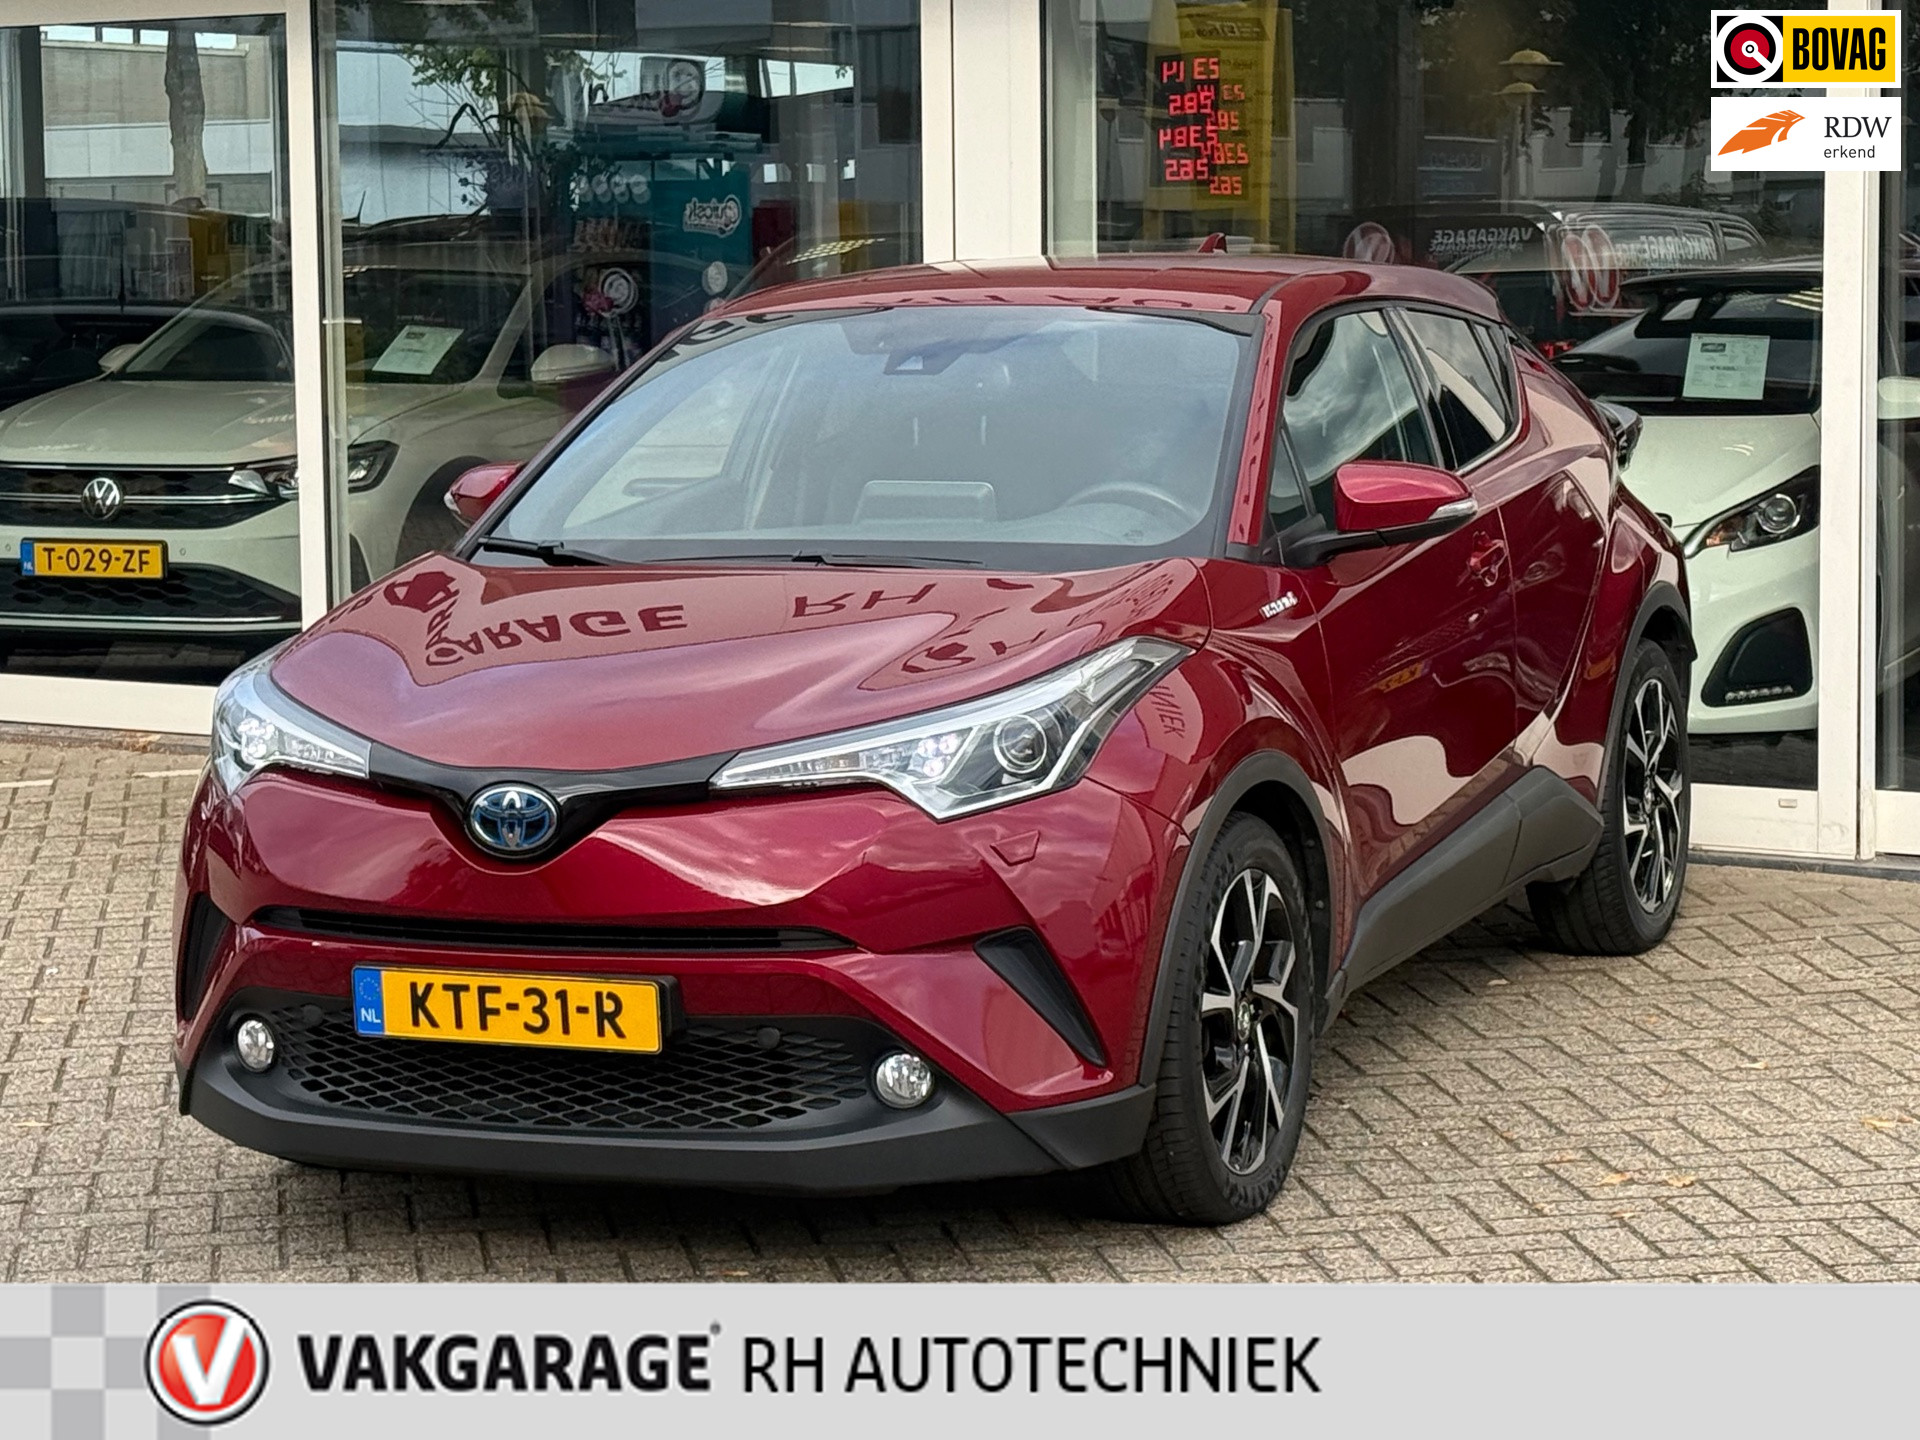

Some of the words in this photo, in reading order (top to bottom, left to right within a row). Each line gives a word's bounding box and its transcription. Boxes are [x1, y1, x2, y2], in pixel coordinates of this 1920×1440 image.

[42, 547, 150, 574] T-029-ZF
[360, 1007, 382, 1025] NL
[409, 981, 627, 1040] KTF-31-R
